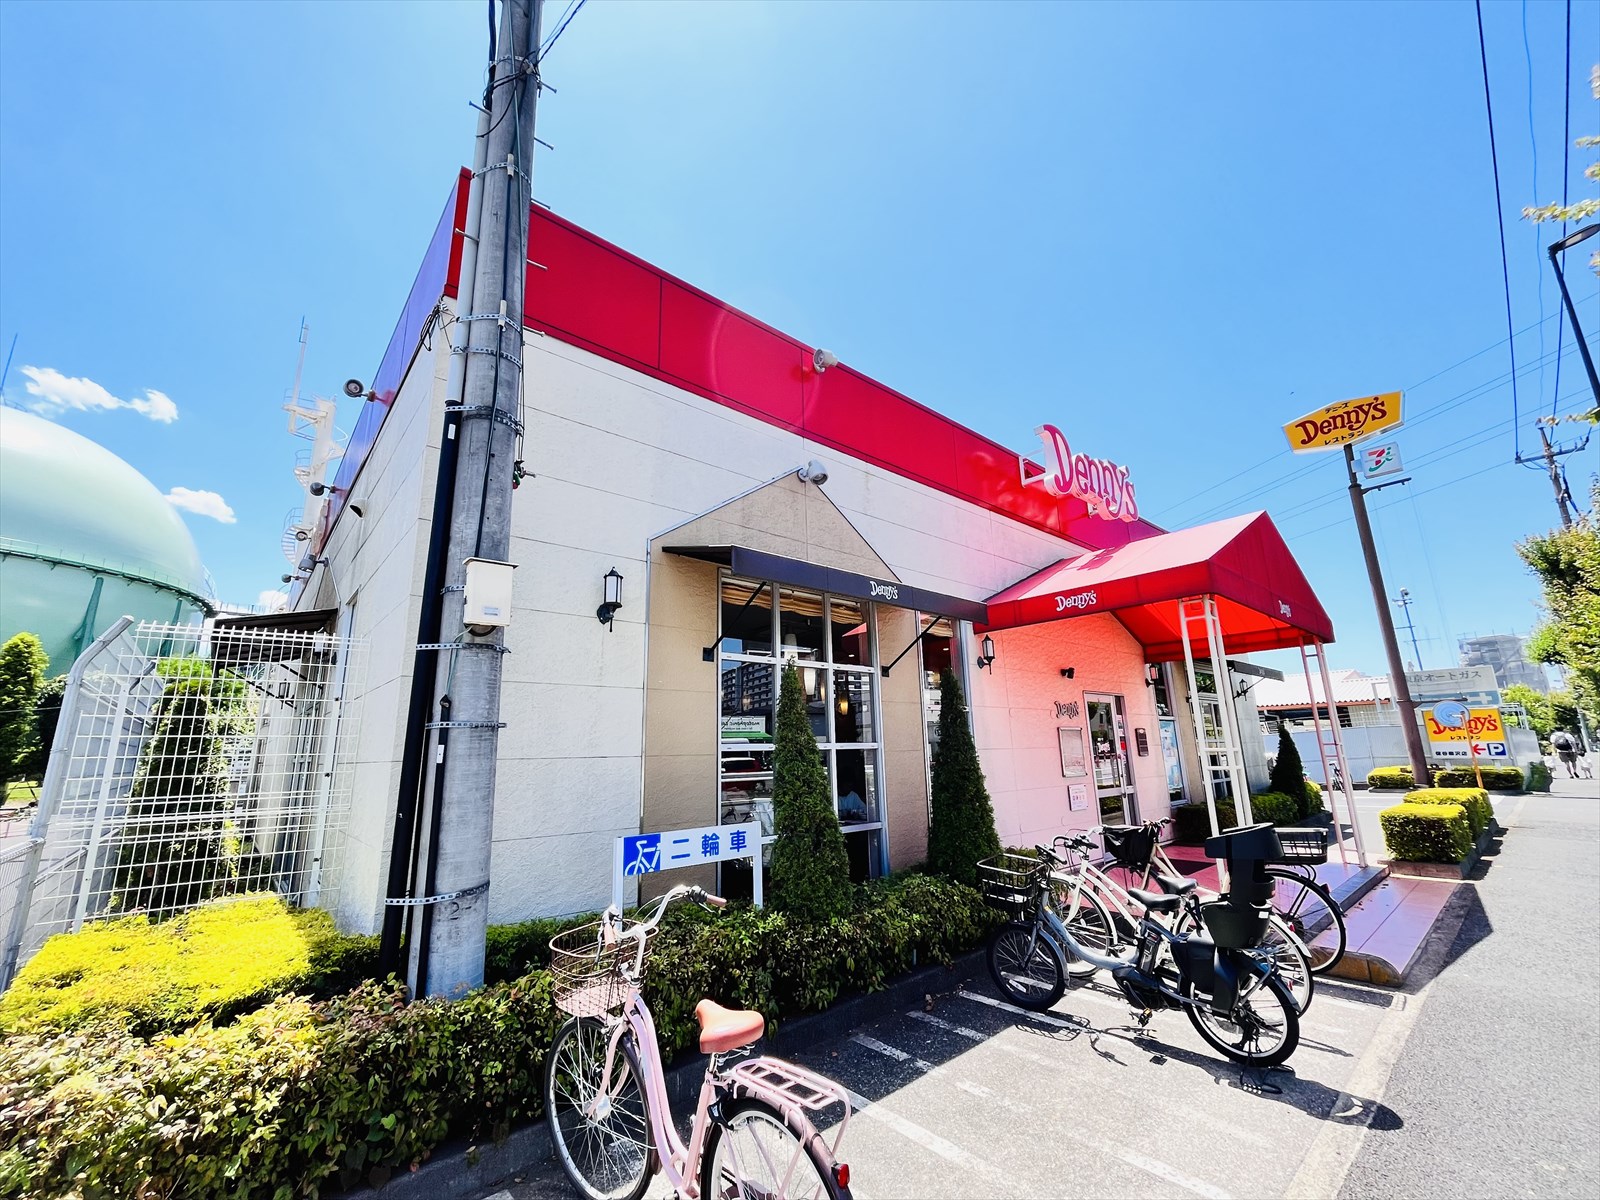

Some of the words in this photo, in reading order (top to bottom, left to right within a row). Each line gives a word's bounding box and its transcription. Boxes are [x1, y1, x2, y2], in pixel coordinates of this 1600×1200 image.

[1295, 396, 1387, 445] Denny's
[1324, 430, 1365, 446] レストラン
[1035, 423, 1139, 521] Denny's
[869, 580, 899, 600] Denny's
[1054, 589, 1097, 612] Denny's
[1428, 714, 1498, 735] Dny's
[1489, 744, 1504, 756] P
[671, 829, 747, 859] 二輪車
